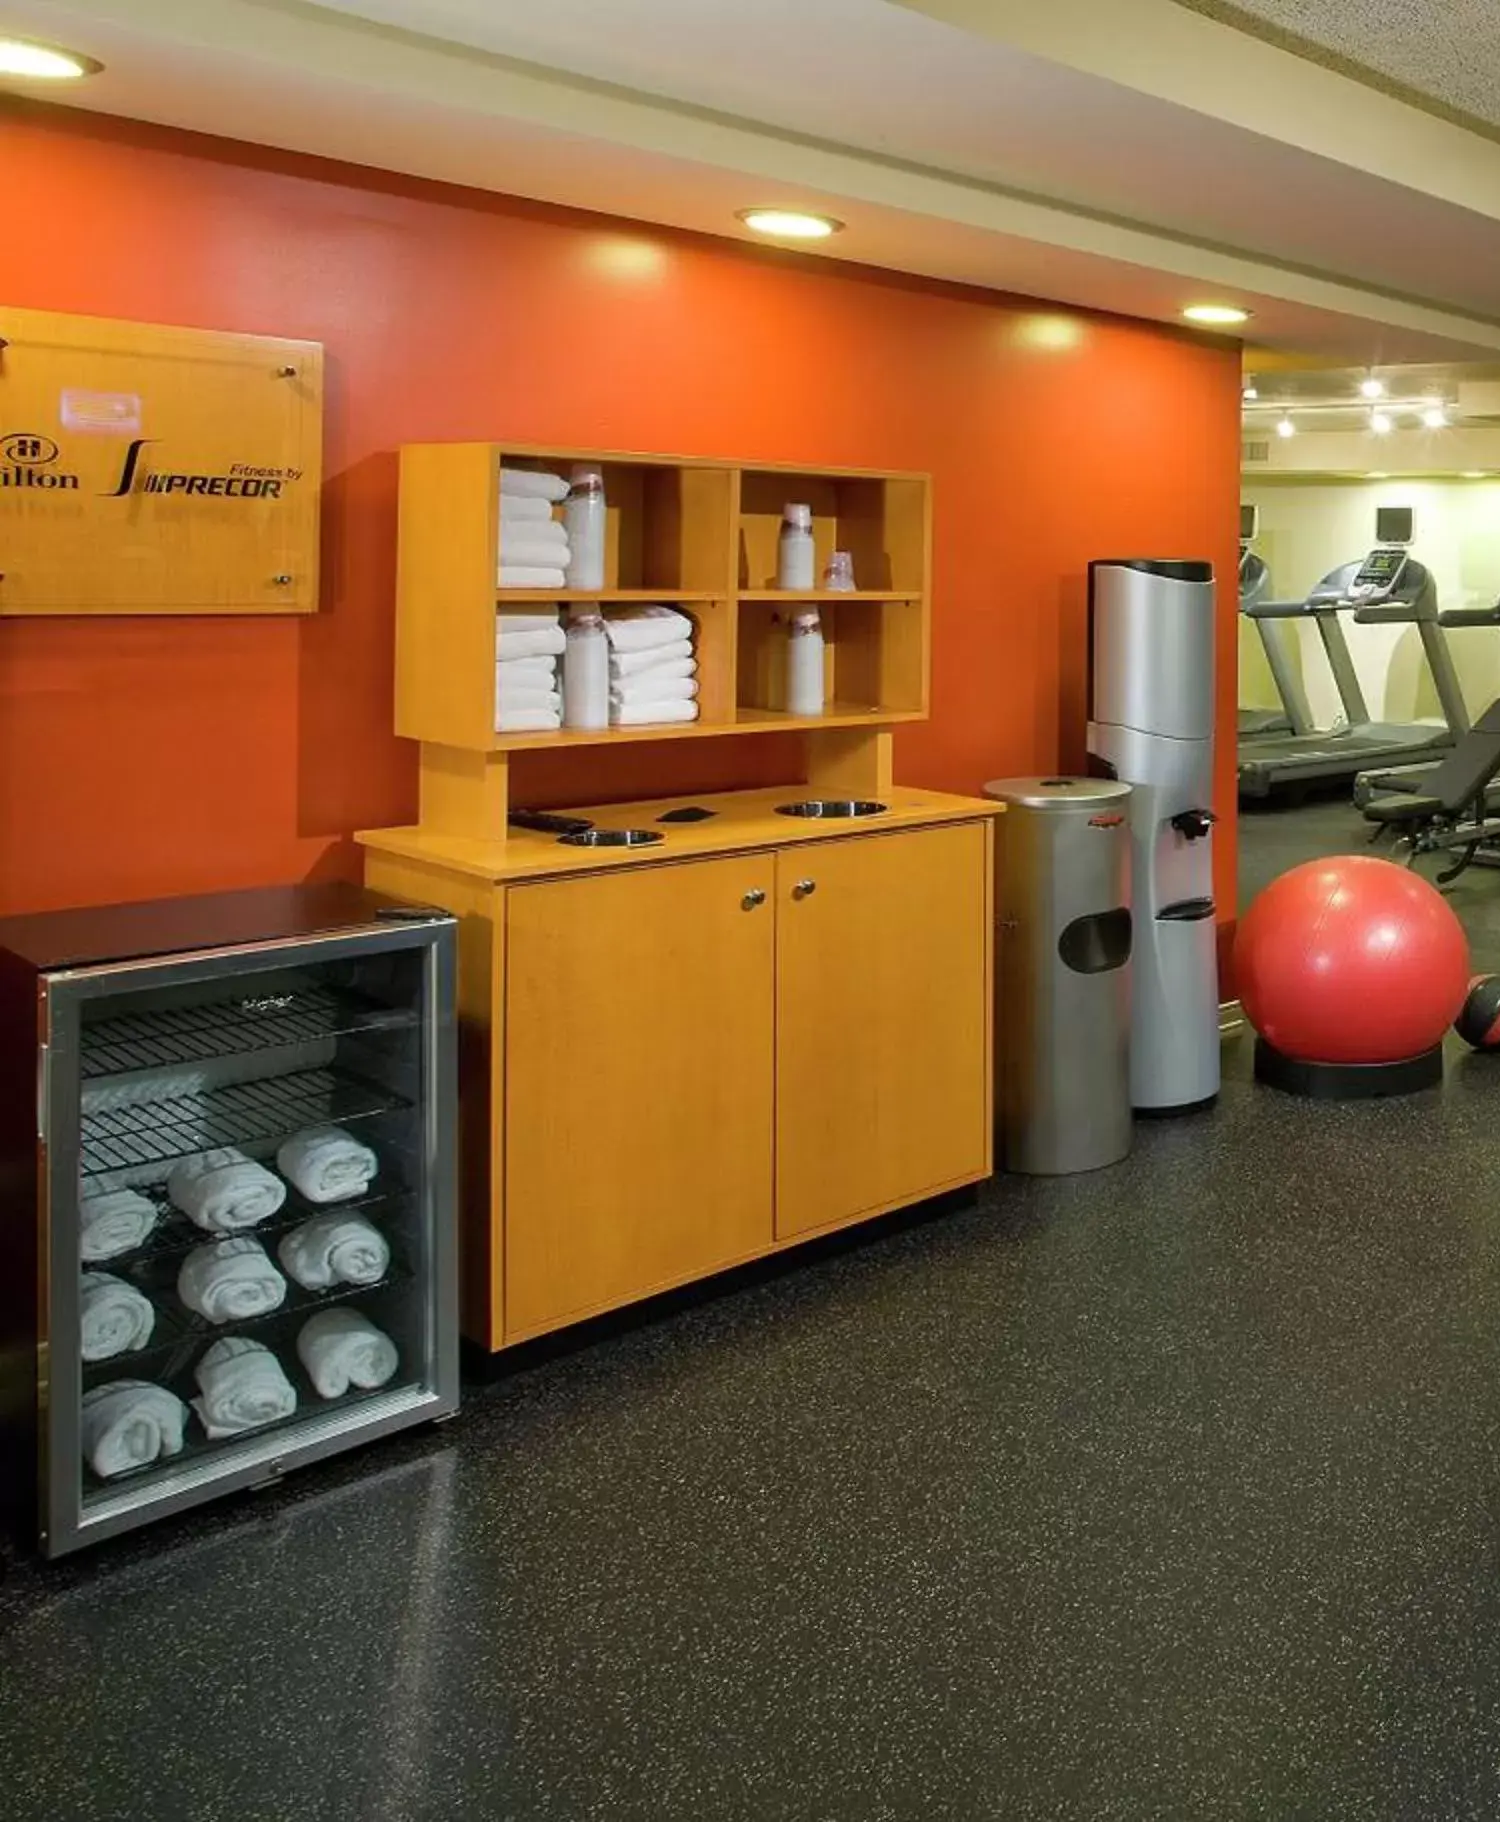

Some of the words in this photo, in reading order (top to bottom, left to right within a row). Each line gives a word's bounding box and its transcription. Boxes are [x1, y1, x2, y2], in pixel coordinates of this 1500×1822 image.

[2, 465, 79, 489] ilton
[229, 464, 282, 478] Fitness
[287, 468, 302, 481] by
[165, 475, 281, 498] PRECOR
